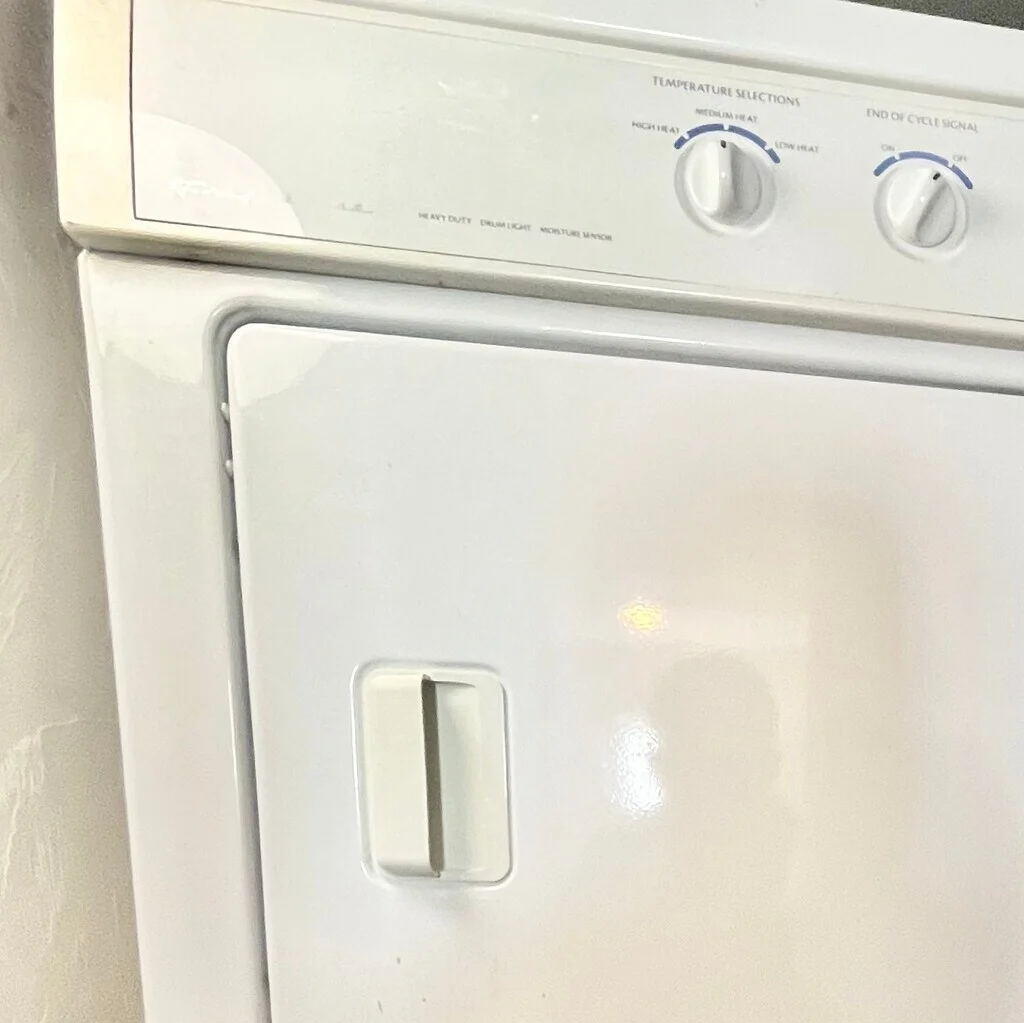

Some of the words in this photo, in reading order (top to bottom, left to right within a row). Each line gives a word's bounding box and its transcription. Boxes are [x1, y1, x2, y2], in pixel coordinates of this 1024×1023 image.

[652, 76, 733, 98] TEMPERATURE
[735, 87, 801, 107] SELECTIONS
[695, 107, 734, 121] MEDIUM
[735, 113, 758, 124] HEAT
[866, 108, 889, 121] END
[890, 111, 905, 122] OF
[906, 113, 941, 128] CYCLE
[941, 117, 979, 133] SIGNAL
[631, 121, 655, 132] HIGH
[656, 124, 680, 134] HEAT
[775, 140, 796, 151] LOW
[796, 143, 819, 153] HEAT
[881, 143, 896, 153] ON
[418, 211, 446, 223] HEAVY
[447, 214, 472, 225] DUTY
[480, 218, 506, 229] DRUM
[540, 226, 582, 239] MOISTURE
[582, 230, 613, 242] SENSOR
